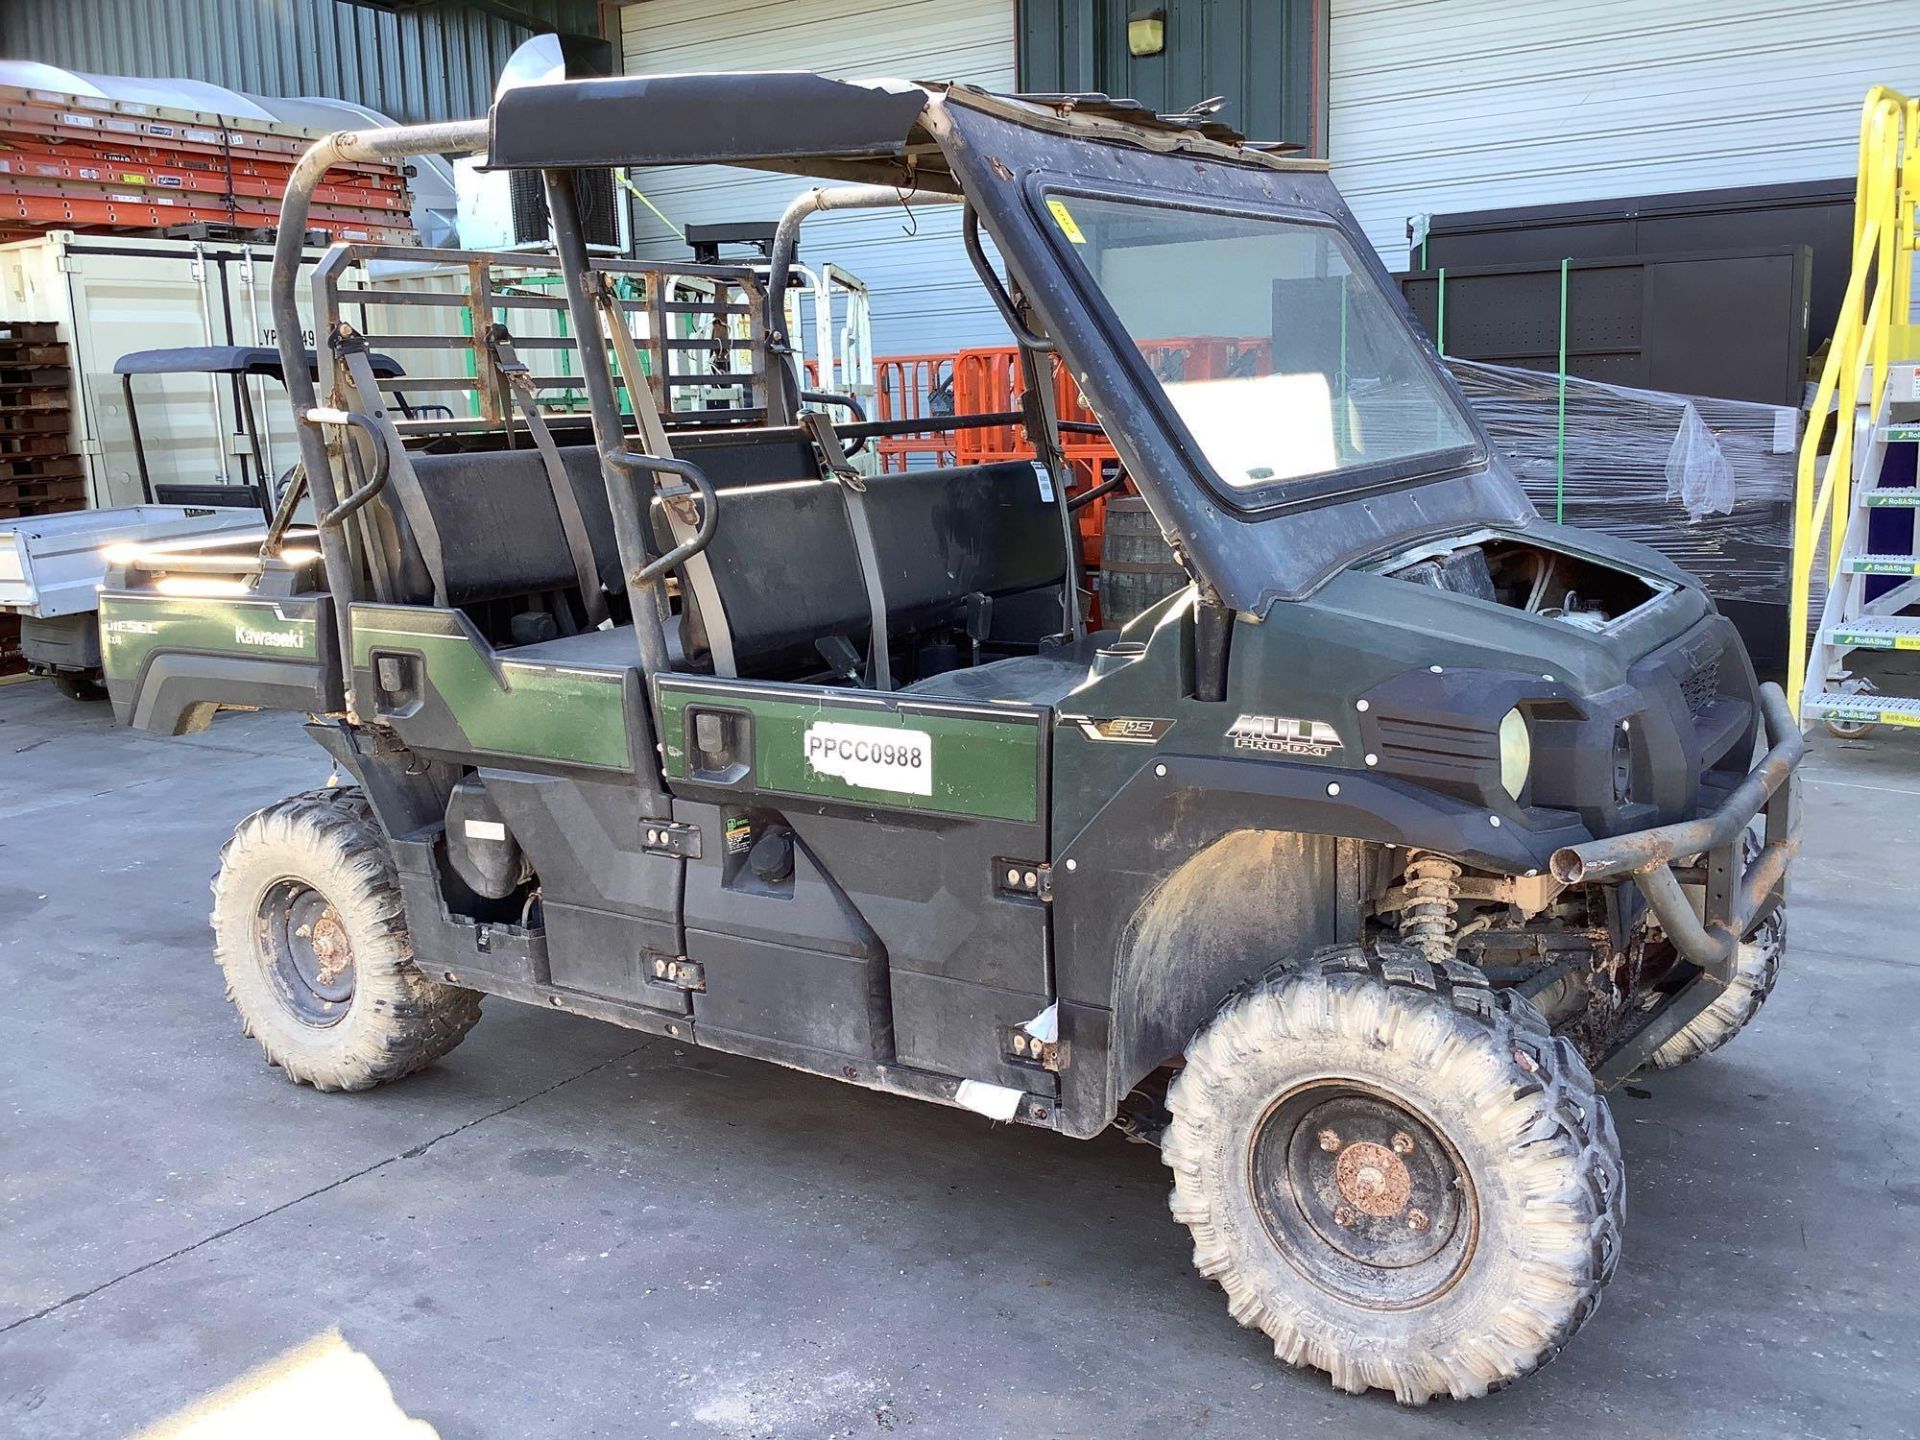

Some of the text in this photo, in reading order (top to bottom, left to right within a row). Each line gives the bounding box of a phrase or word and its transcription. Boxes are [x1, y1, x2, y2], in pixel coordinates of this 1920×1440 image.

[1874, 563, 1911, 573] RollAStep
[235, 625, 304, 648] Kawasaki
[1854, 637, 1893, 646] RollAStep
[1838, 710, 1878, 720] RollAStep
[810, 736, 922, 769] PPCC0988
